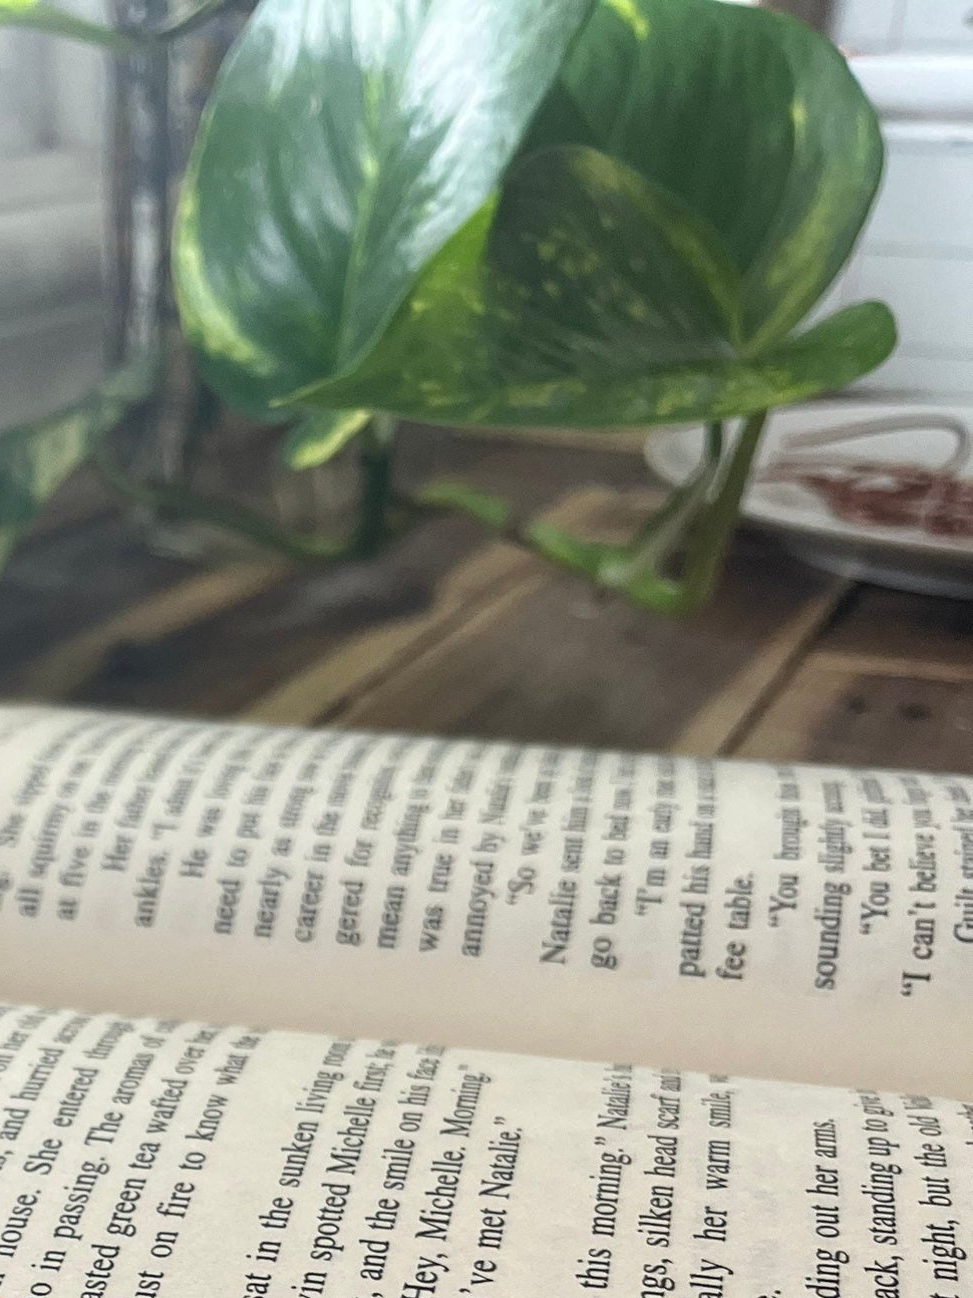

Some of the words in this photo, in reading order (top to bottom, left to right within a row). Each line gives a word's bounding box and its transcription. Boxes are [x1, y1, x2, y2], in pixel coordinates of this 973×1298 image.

[235, 811, 261, 840] put
[313, 810, 341, 837] the
[390, 803, 430, 876] anything
[432, 826, 461, 845] in
[471, 831, 506, 853] by
[684, 821, 714, 860] hand
[100, 834, 133, 872] Her
[178, 848, 209, 878] He
[225, 846, 250, 868] to
[270, 836, 292, 857] as
[310, 842, 332, 863] in
[343, 838, 375, 868] for
[602, 847, 627, 866] to
[648, 838, 670, 860] an
[817, 818, 853, 873] slightly
[861, 845, 891, 872] bet
[908, 833, 937, 893] believe
[58, 846, 91, 888] five
[427, 852, 455, 893] true
[680, 864, 711, 895] his
[213, 878, 241, 935] need
[253, 867, 289, 938] nearly
[294, 870, 324, 943] career
[335, 880, 364, 947] gered
[376, 885, 406, 949] mean
[460, 860, 495, 957] annoyed
[539, 880, 577, 964] Natalie
[560, 836, 584, 873] sent
[588, 874, 622, 925] back
[723, 873, 754, 930] table.
[418, 905, 444, 952] was
[678, 901, 707, 978] patted
[813, 881, 852, 990] sounding
[590, 936, 618, 970] go
[714, 941, 747, 980] fee
[9, 1046, 65, 1101] hurried
[213, 1053, 249, 1085] what
[294, 1070, 345, 1114] living
[649, 1093, 681, 1130] scarf
[22, 1137, 63, 1175] She
[52, 1066, 99, 1128] entered
[183, 1093, 228, 1142] know
[325, 1096, 376, 1175] Michelle
[397, 1110, 424, 1133] on
[812, 1118, 838, 1159] arms.
[30, 1249, 67, 1272] in
[52, 1156, 110, 1241] passing.
[83, 1110, 124, 1146] The
[111, 1052, 155, 1105] aromas
[105, 1177, 147, 1237] green
[127, 1141, 161, 1170] tea
[145, 1078, 188, 1134] wafted
[177, 1150, 207, 1171] to
[278, 1120, 319, 1188] sunken
[380, 1138, 415, 1191] smile
[642, 1134, 678, 1178] head
[705, 1139, 731, 1190] warm
[866, 1135, 900, 1157] up
[912, 1142, 948, 1168] the
[155, 1181, 195, 1218] fire
[414, 1146, 465, 1241] Michelle.
[804, 1163, 839, 1197] her
[917, 1175, 953, 1207] but
[257, 1196, 294, 1229] the
[309, 1182, 351, 1261] spotted
[364, 1197, 400, 1230] the
[636, 1184, 674, 1248] silken
[692, 1204, 728, 1242] her
[810, 1203, 840, 1238] out
[860, 1161, 902, 1246] standing
[149, 1230, 179, 1258] on
[477, 1207, 507, 1250] met
[245, 1240, 282, 1263] in
[357, 1238, 390, 1281] and
[574, 1247, 612, 1289] this
[920, 1219, 967, 1281] night,
